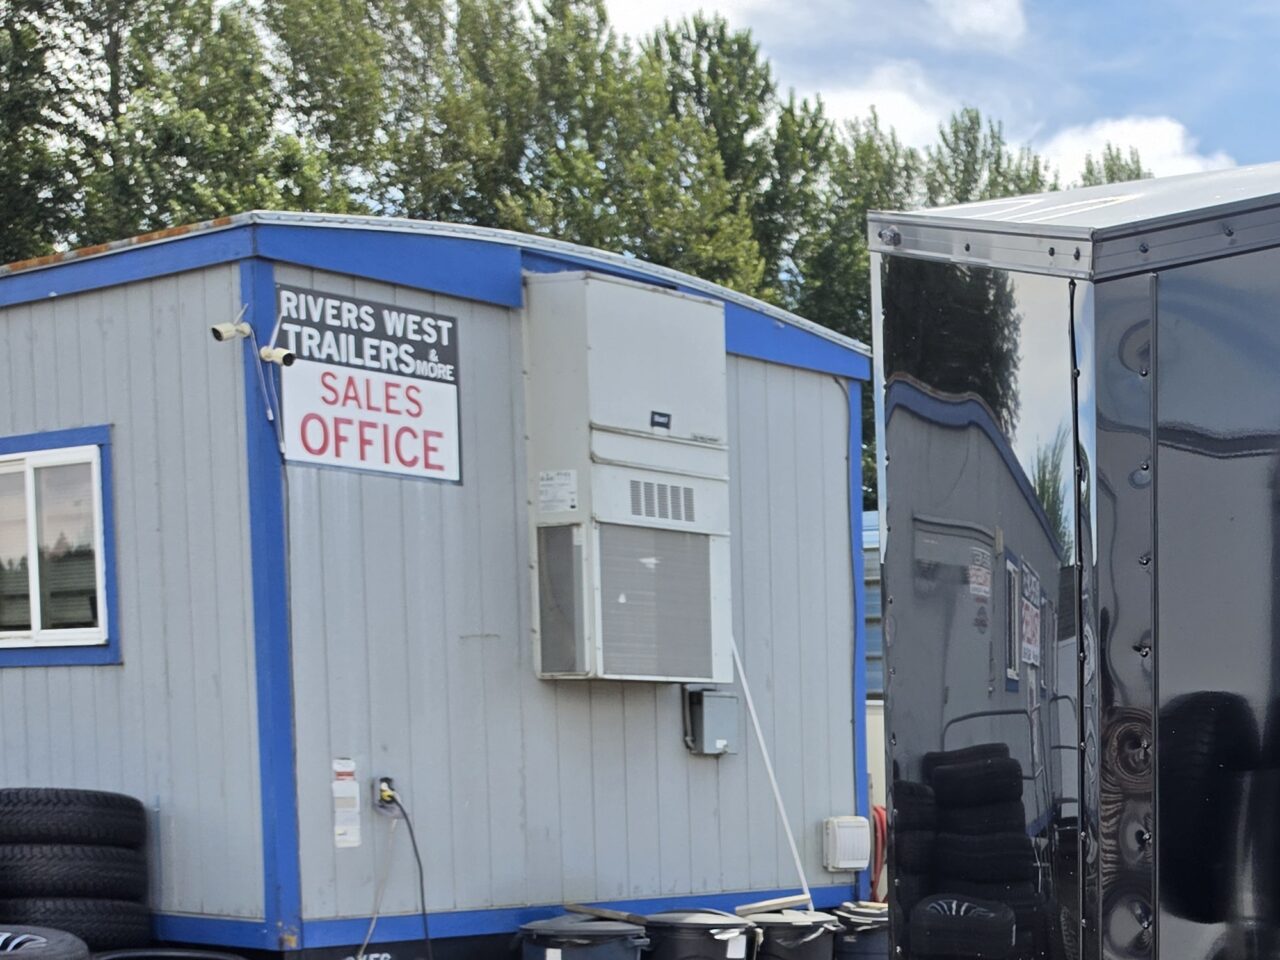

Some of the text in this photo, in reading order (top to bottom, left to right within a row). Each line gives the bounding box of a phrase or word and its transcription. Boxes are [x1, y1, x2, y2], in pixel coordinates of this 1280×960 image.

[280, 290, 453, 346] RIVERS WEST
[281, 323, 455, 381] TRAILERS & MORE
[321, 371, 423, 418] SALES
[300, 412, 444, 471] OFFICE
